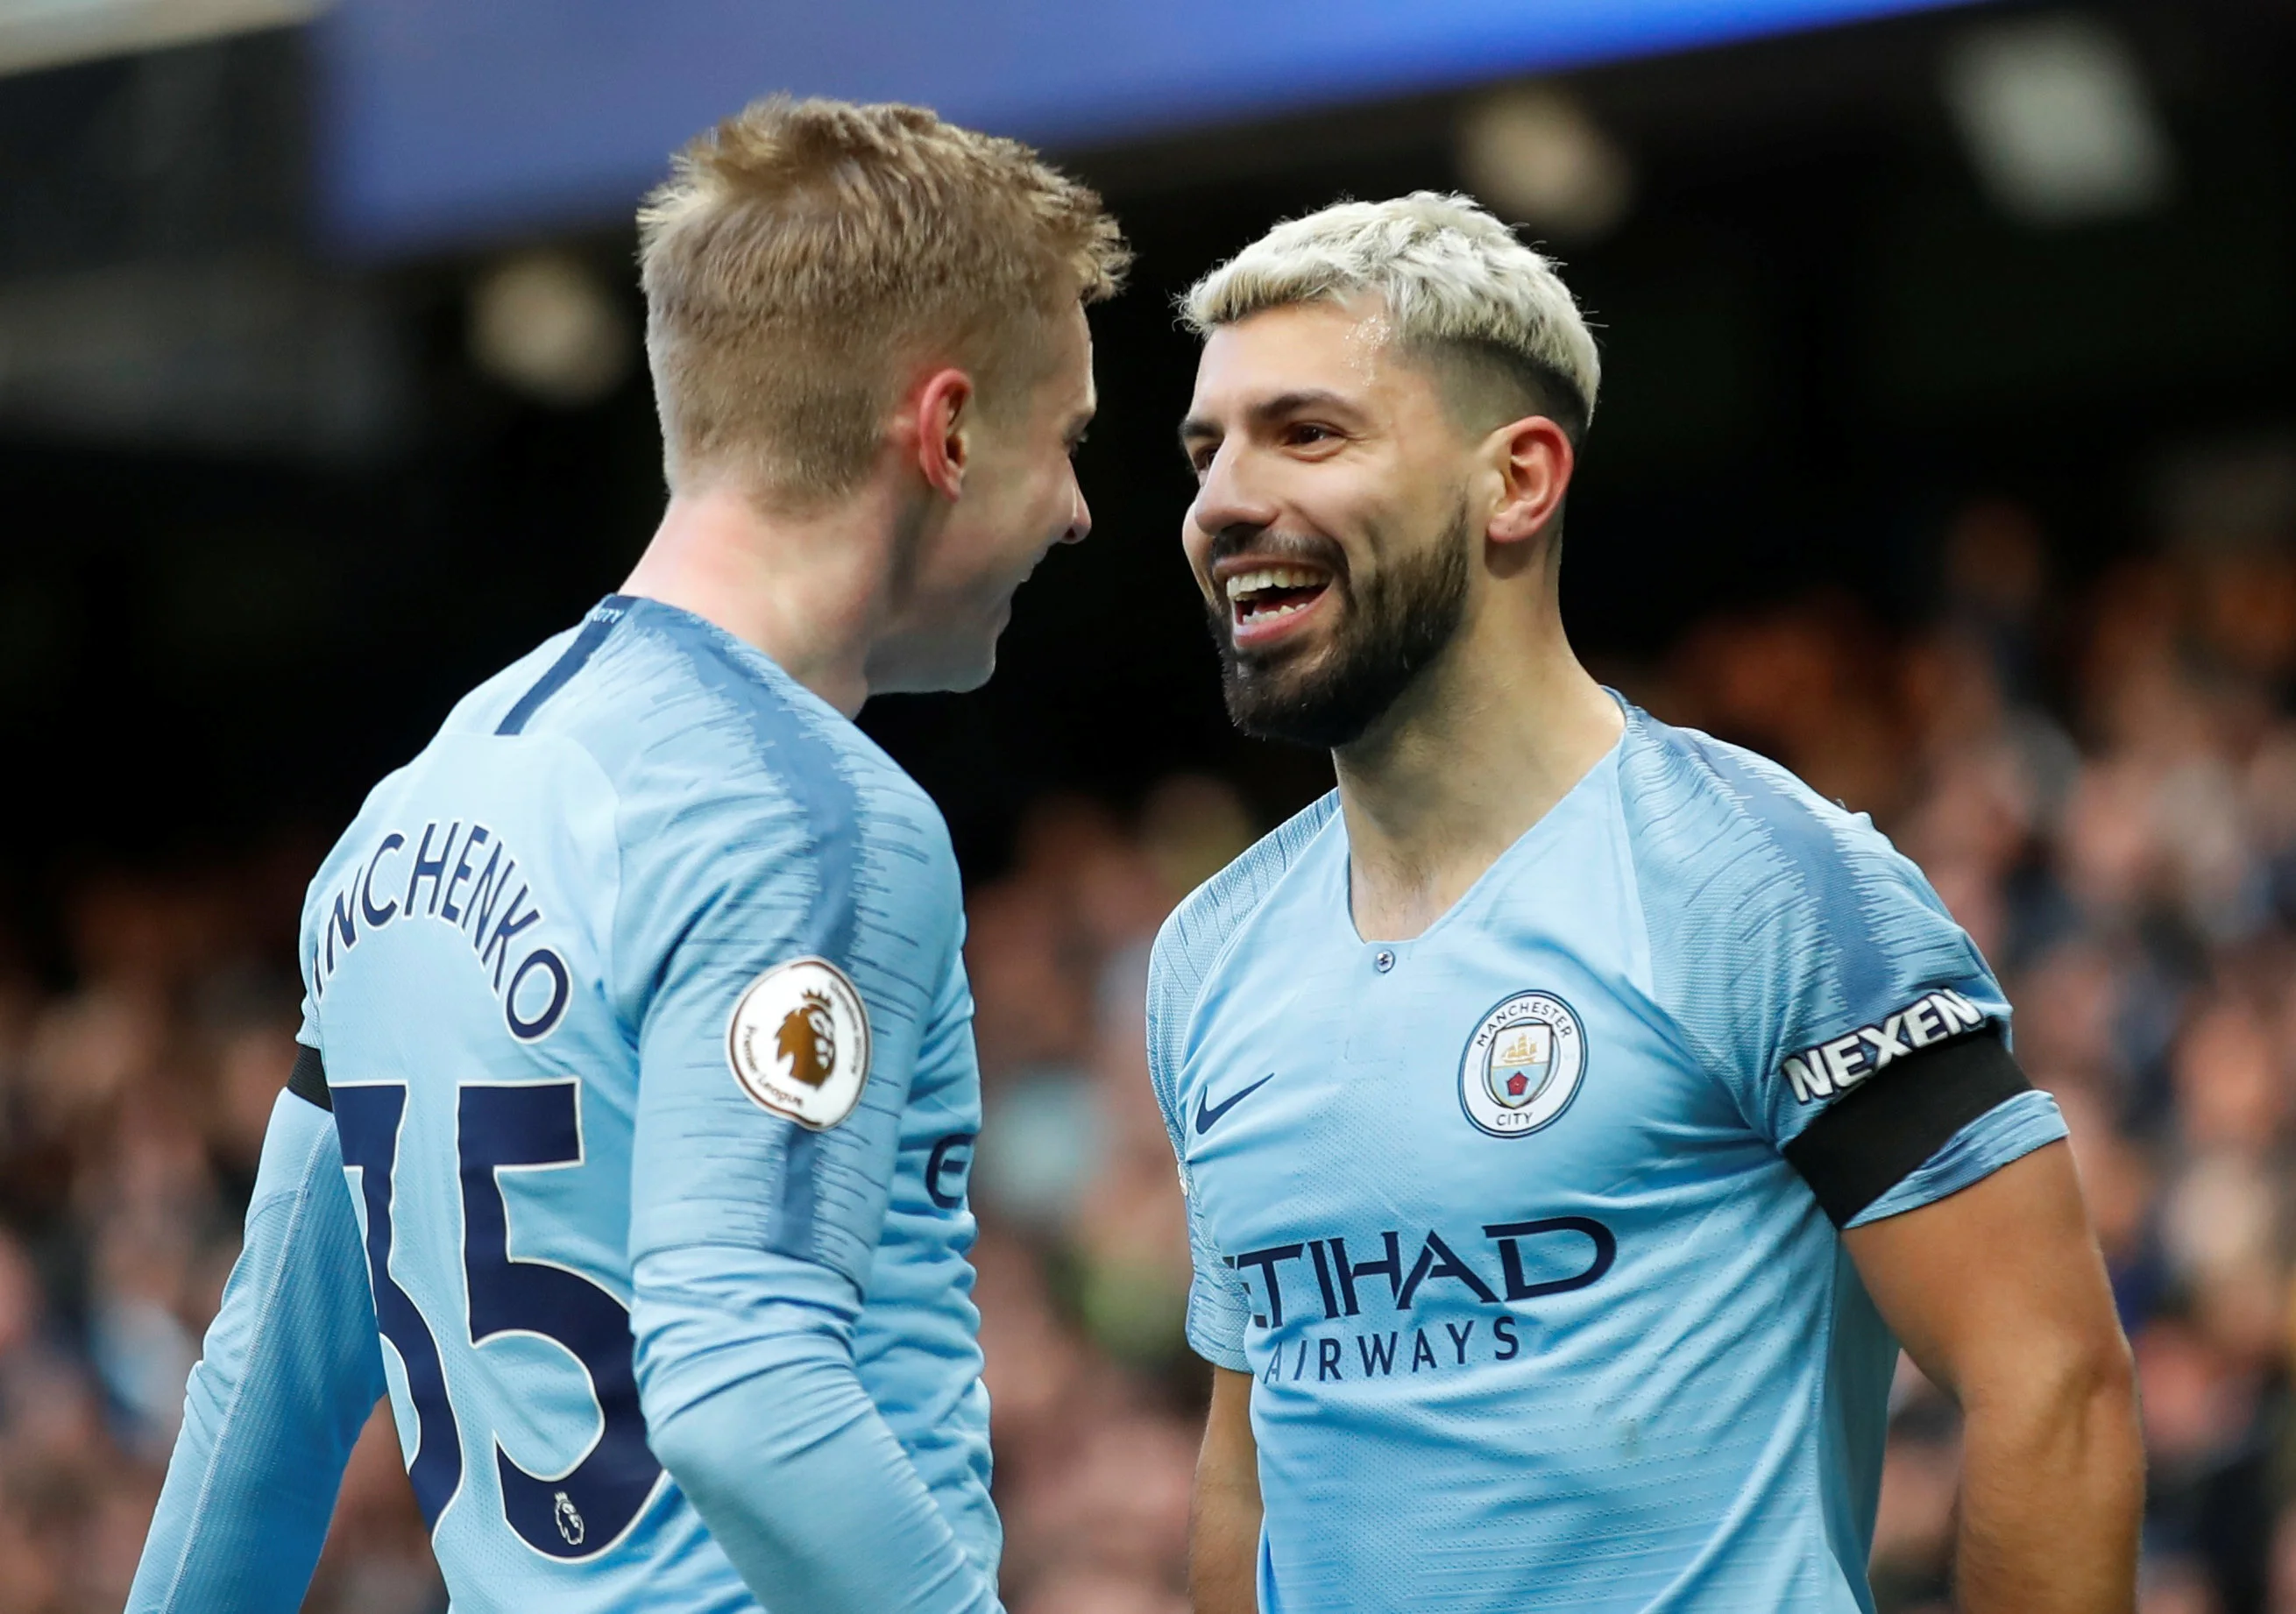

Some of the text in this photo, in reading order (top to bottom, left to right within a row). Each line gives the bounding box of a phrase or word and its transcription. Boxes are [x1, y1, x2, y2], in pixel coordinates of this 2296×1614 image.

[1477, 1002, 1572, 1047] MANCHESTER
[1782, 988, 1982, 1102] NEXEN
[1496, 1112, 1534, 1126] CITY
[1222, 1216, 1619, 1330] TIHAD
[1263, 1317, 1521, 1384] AIRWAYS
